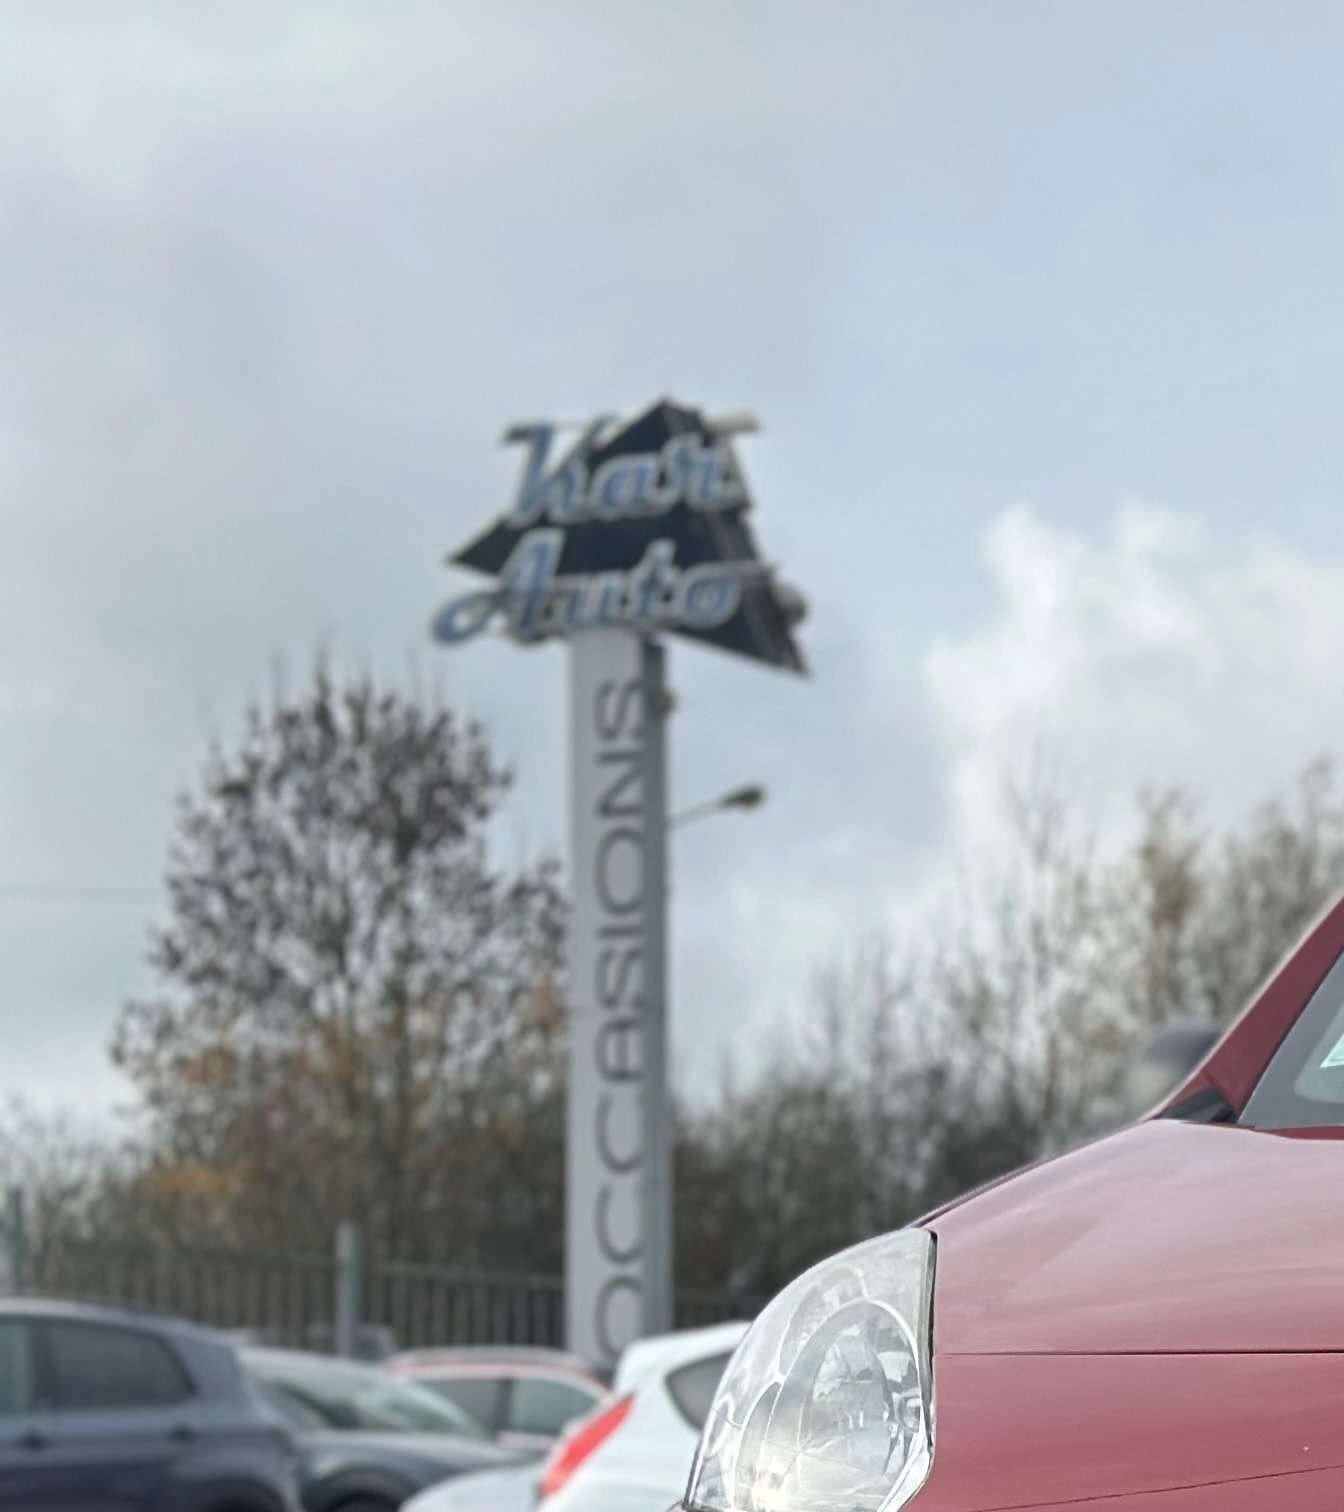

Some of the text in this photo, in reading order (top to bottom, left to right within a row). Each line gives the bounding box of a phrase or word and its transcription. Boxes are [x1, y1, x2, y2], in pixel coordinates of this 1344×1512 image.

[500, 417, 752, 528] Kar
[430, 526, 778, 645] Auto
[592, 677, 645, 1362] OCCASIONS
